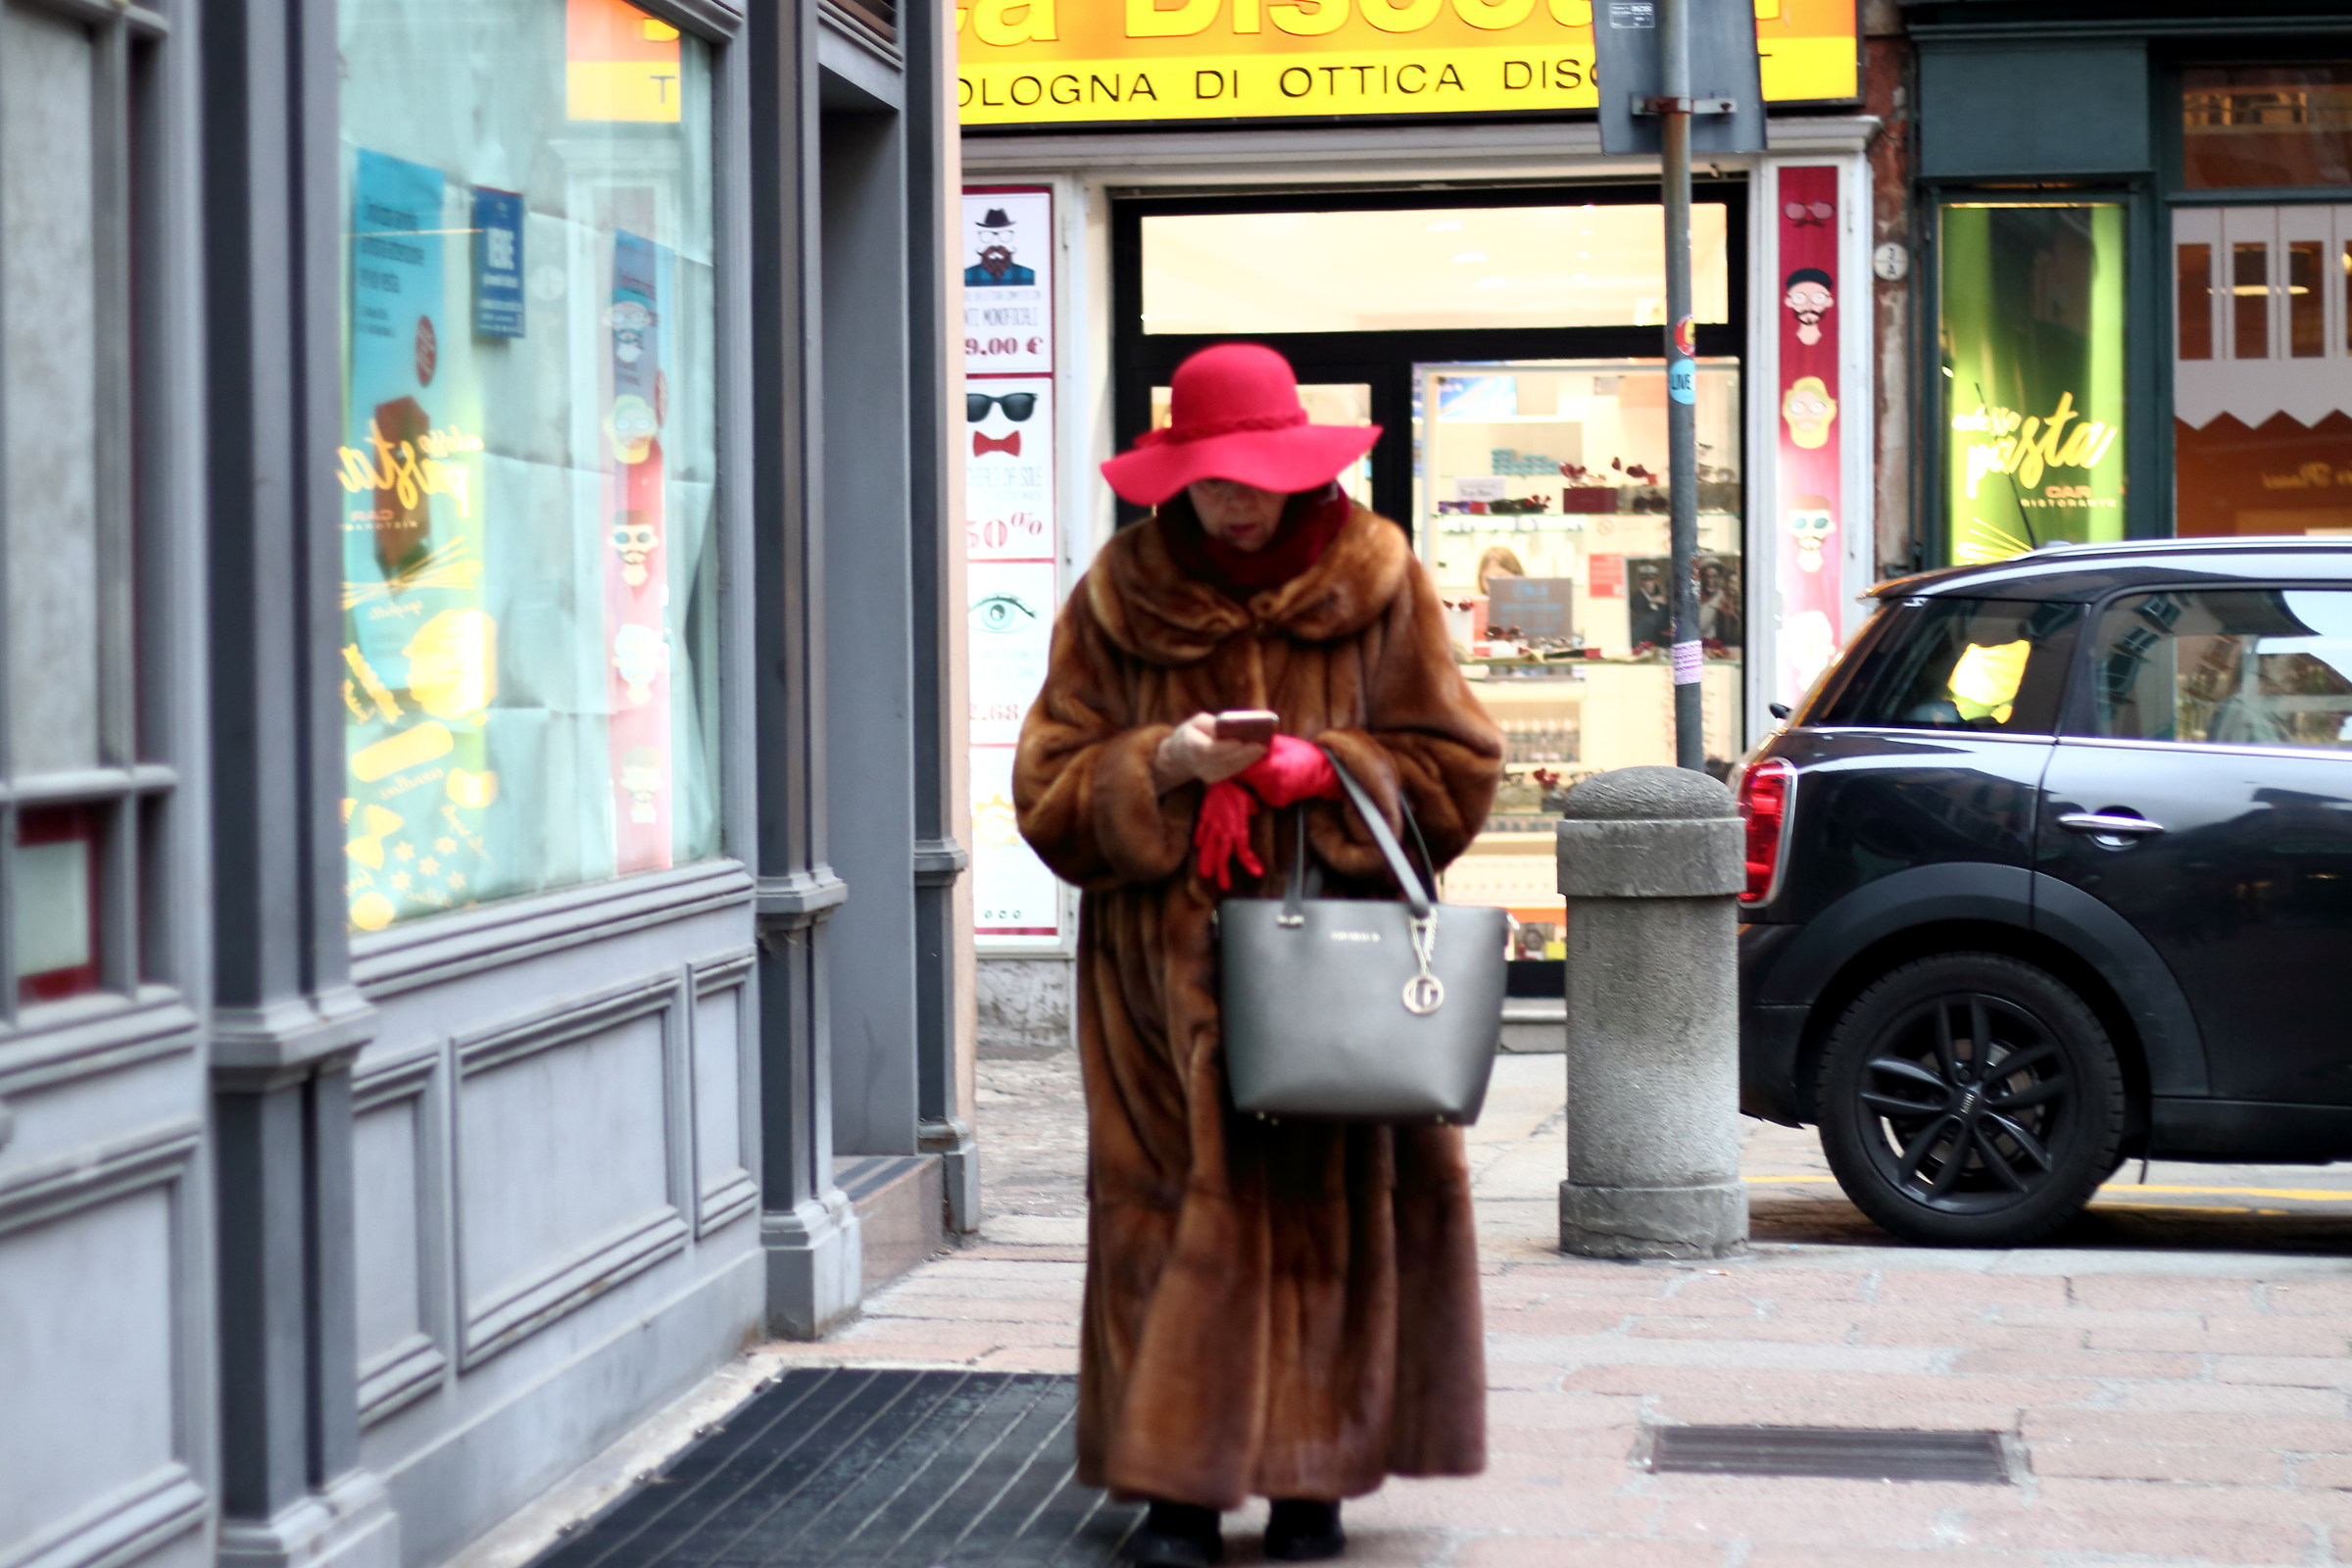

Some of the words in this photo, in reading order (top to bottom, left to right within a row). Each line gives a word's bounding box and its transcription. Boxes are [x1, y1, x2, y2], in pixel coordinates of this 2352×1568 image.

[1196, 70, 1238, 100] DI
[1279, 63, 1465, 98] OTTICA
[1504, 59, 1599, 90] DIS
